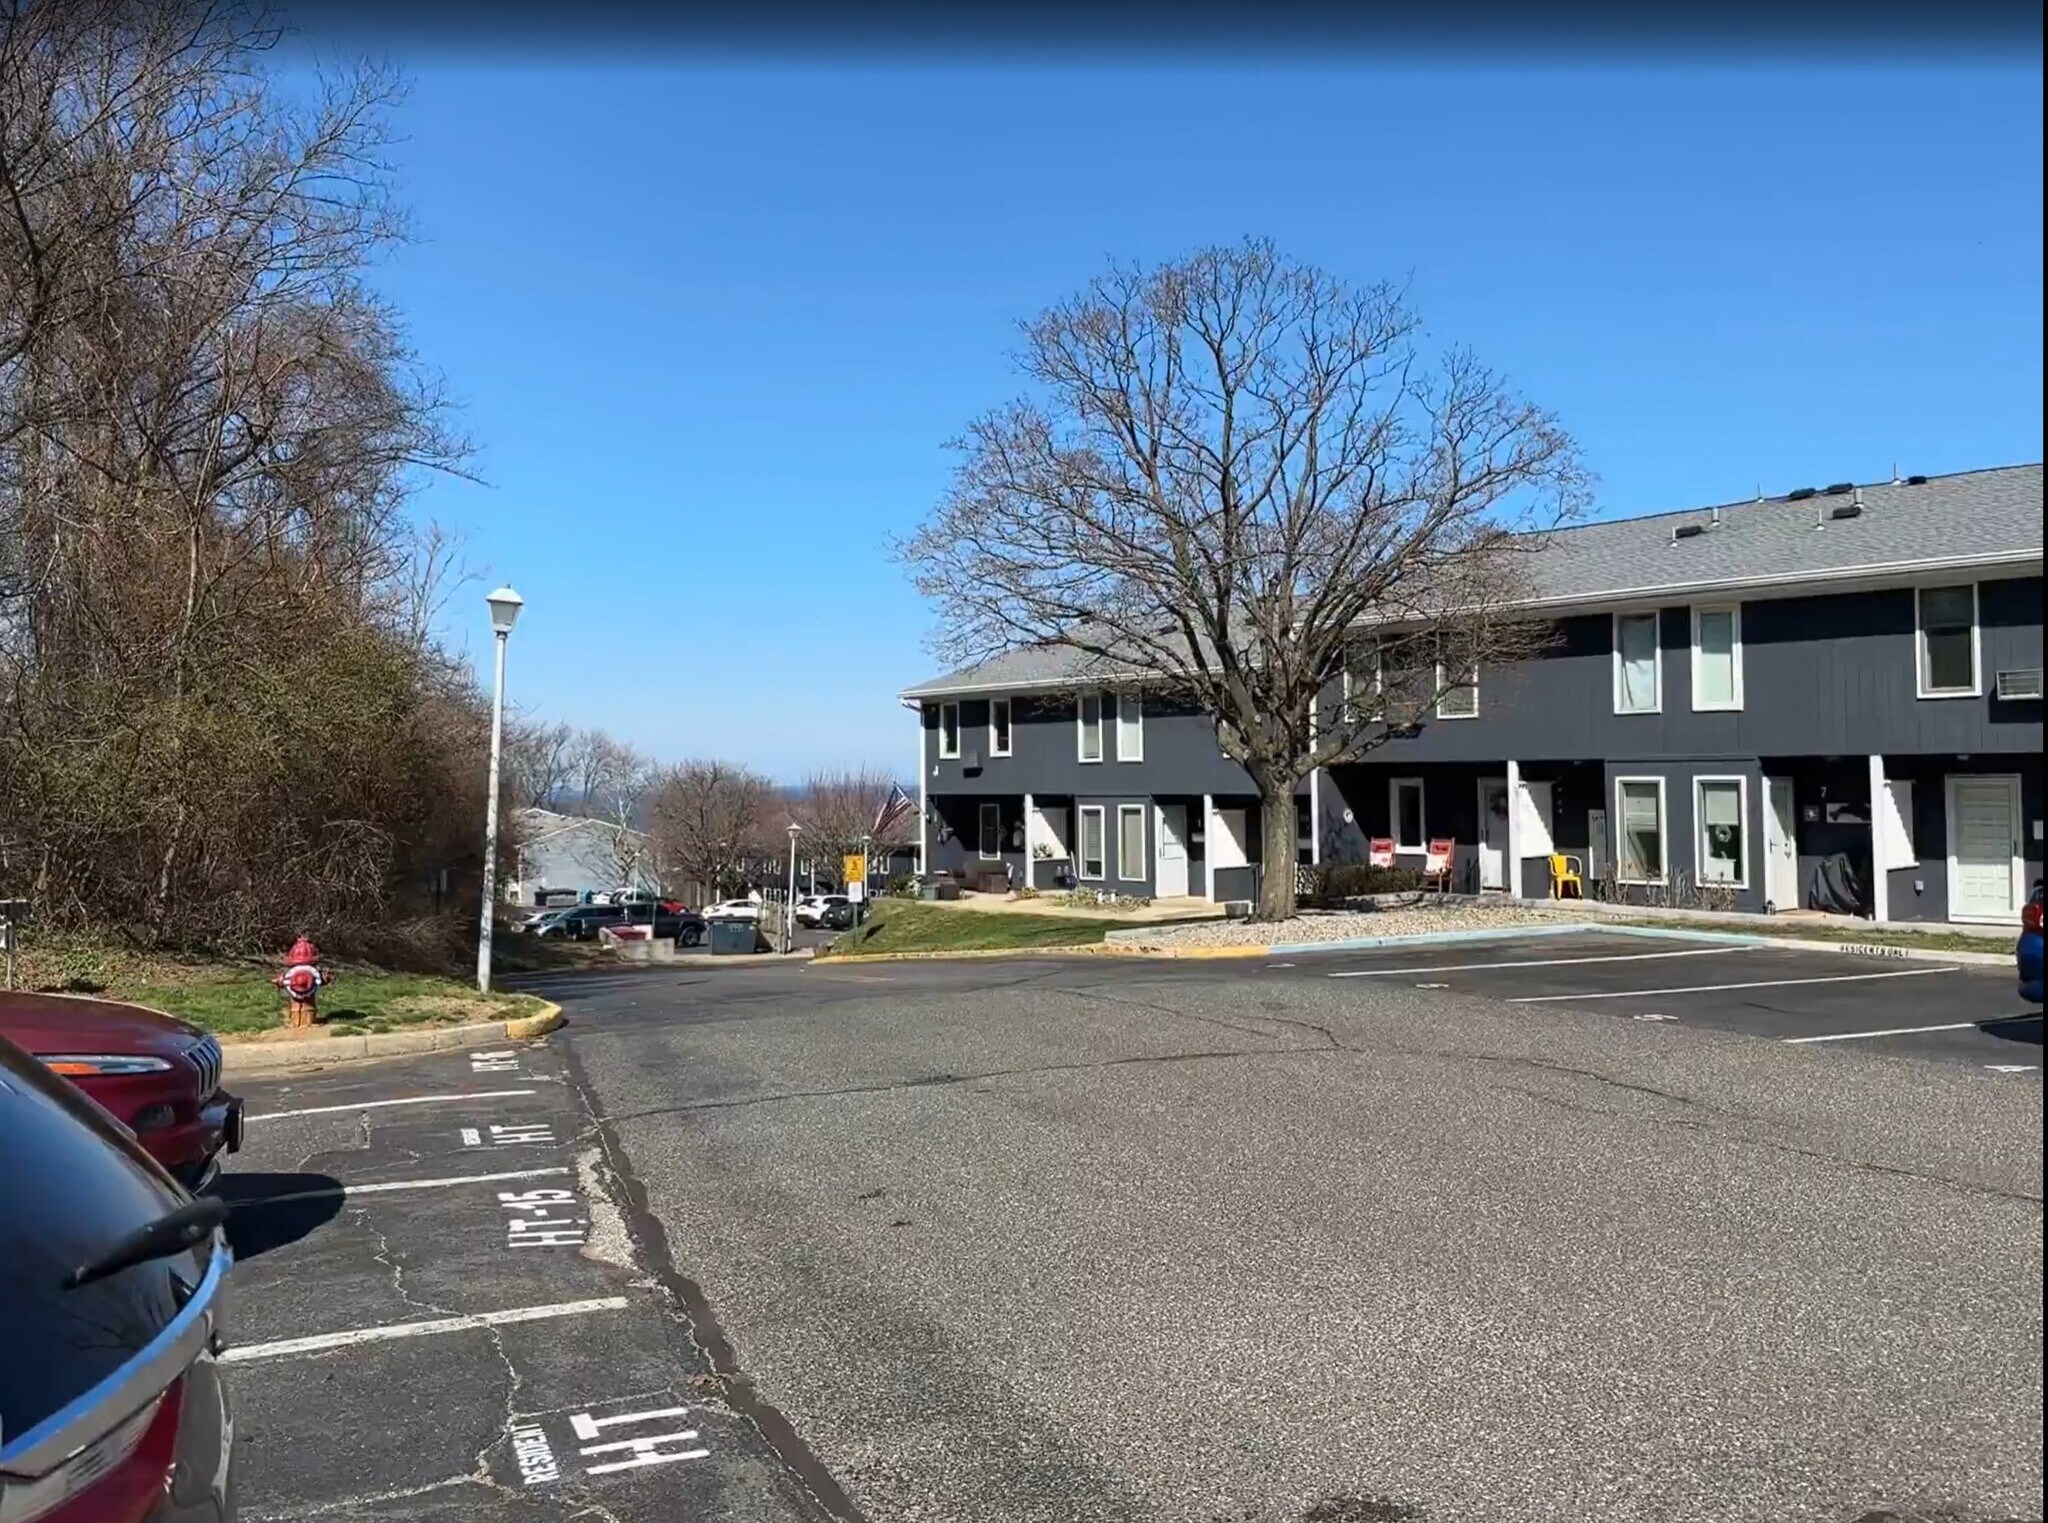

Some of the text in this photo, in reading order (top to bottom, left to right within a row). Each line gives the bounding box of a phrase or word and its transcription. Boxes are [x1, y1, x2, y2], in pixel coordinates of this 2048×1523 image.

[1820, 786, 1827, 798] 7
[490, 1124, 556, 1144] HT
[498, 1188, 587, 1248] HT-15
[511, 1422, 561, 1485] RESIDENT
[569, 1406, 711, 1476] HT
